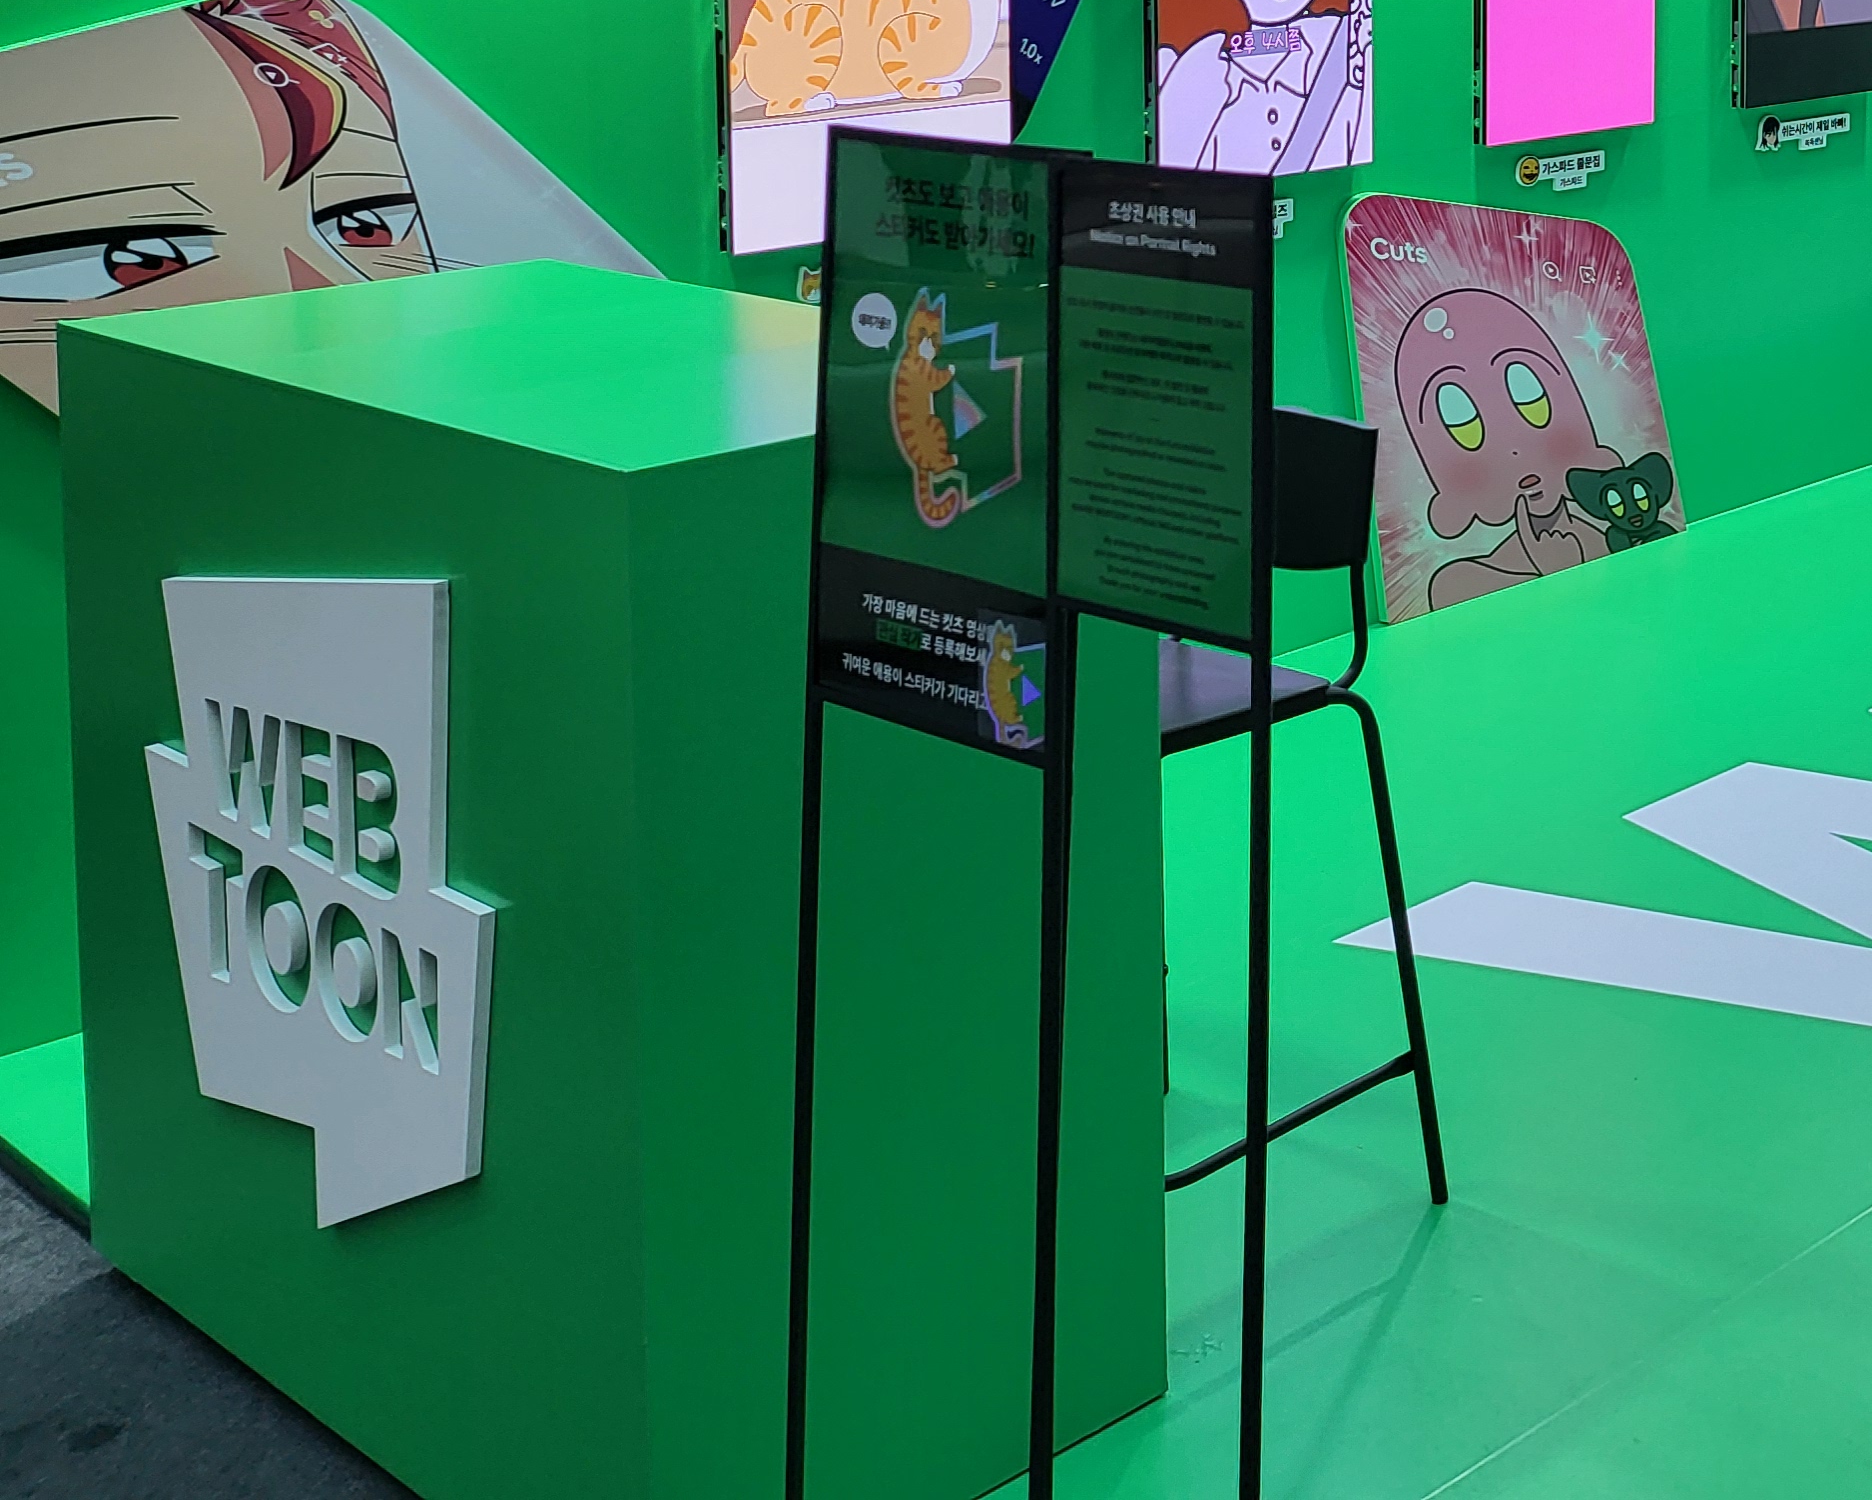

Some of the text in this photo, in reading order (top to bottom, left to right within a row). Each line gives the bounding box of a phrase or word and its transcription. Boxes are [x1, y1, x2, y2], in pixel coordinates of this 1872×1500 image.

[1019, 37, 1043, 65] 1.0x
[1230, 28, 1301, 54] 오후 4시쯤
[1782, 121, 1815, 137] 쉬는시간이
[1542, 159, 1575, 175] 가스파드
[1560, 176, 1583, 187] 가스파드
[1146, 204, 1169, 226] 사용
[1172, 208, 1196, 229] 안내
[1370, 236, 1429, 265] Cuts
[862, 593, 884, 615] 가장
[885, 599, 918, 624] 마음에
[918, 607, 941, 630] 드는
[966, 619, 992, 642] 영상
[933, 634, 987, 667] 등록해보세
[842, 652, 871, 676] 귀여운
[872, 662, 902, 687] 애용이
[904, 671, 945, 699] 스티커가
[205, 698, 401, 901] WEB
[188, 821, 440, 1075] TOON
